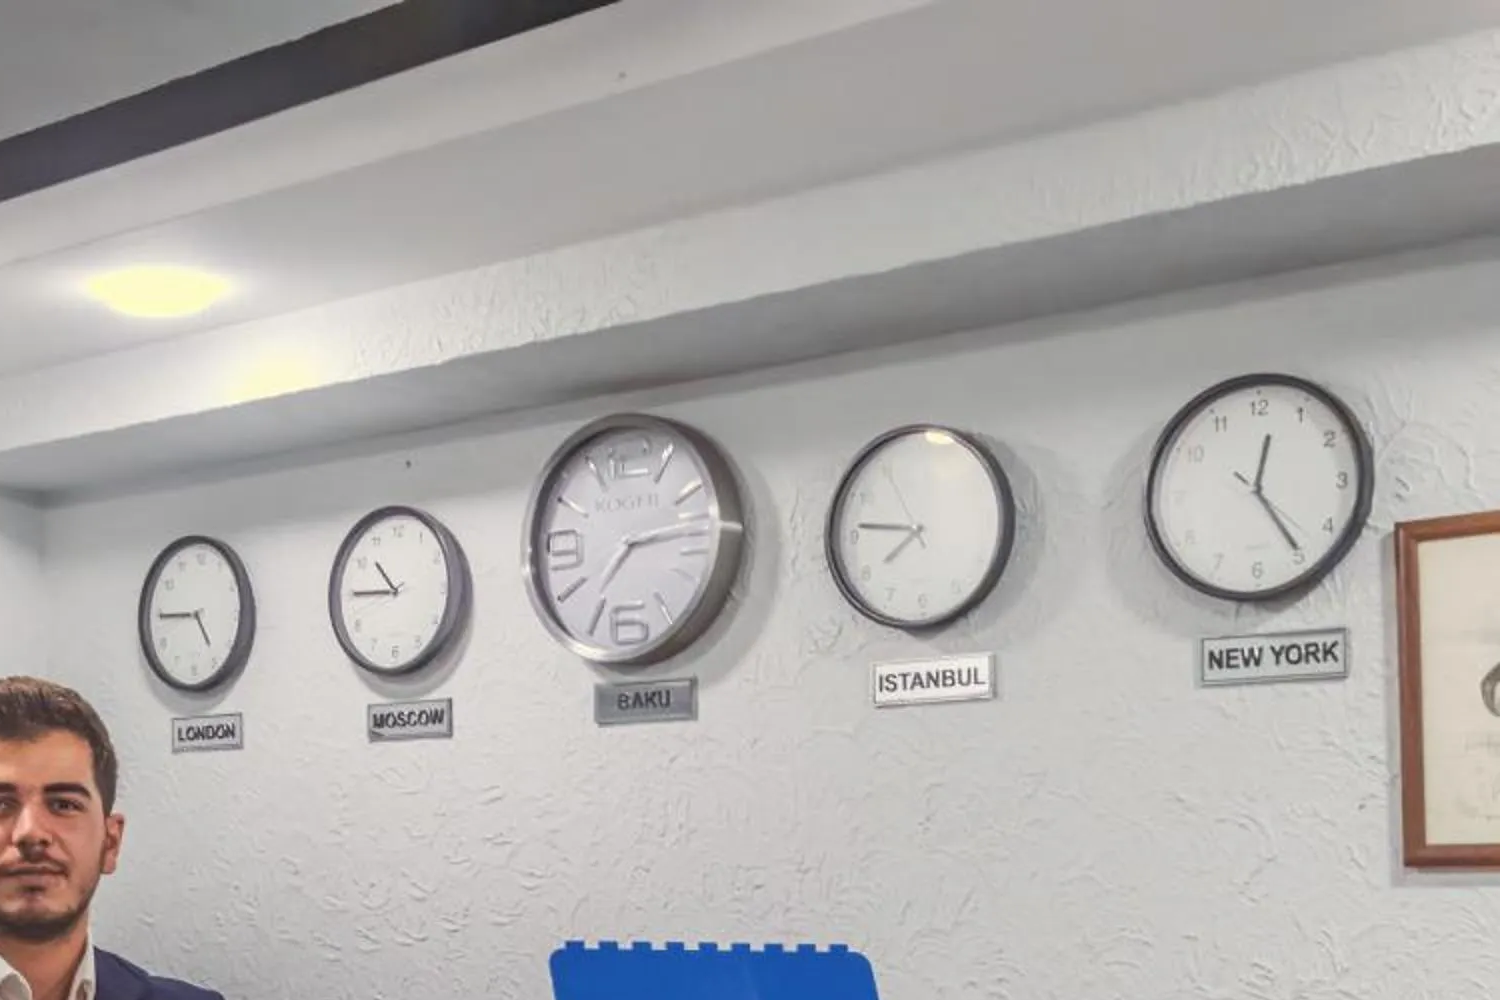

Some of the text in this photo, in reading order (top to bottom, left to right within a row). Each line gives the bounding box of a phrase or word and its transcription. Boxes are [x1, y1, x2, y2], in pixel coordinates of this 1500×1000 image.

[1250, 400, 1269, 416] 12
[1213, 416, 1228, 432] 11
[1323, 431, 1336, 448] 2
[1336, 472, 1348, 489] 3
[1322, 518, 1333, 534] 4
[548, 529, 585, 572] 9
[1251, 562, 1263, 579] 6
[610, 601, 649, 646] 6
[1207, 640, 1340, 671] NEW YORK
[878, 667, 986, 693] ISTANBUL
[617, 689, 672, 711] BAKU
[372, 707, 445, 730] MOSCOW
[177, 723, 236, 743] LONDON
